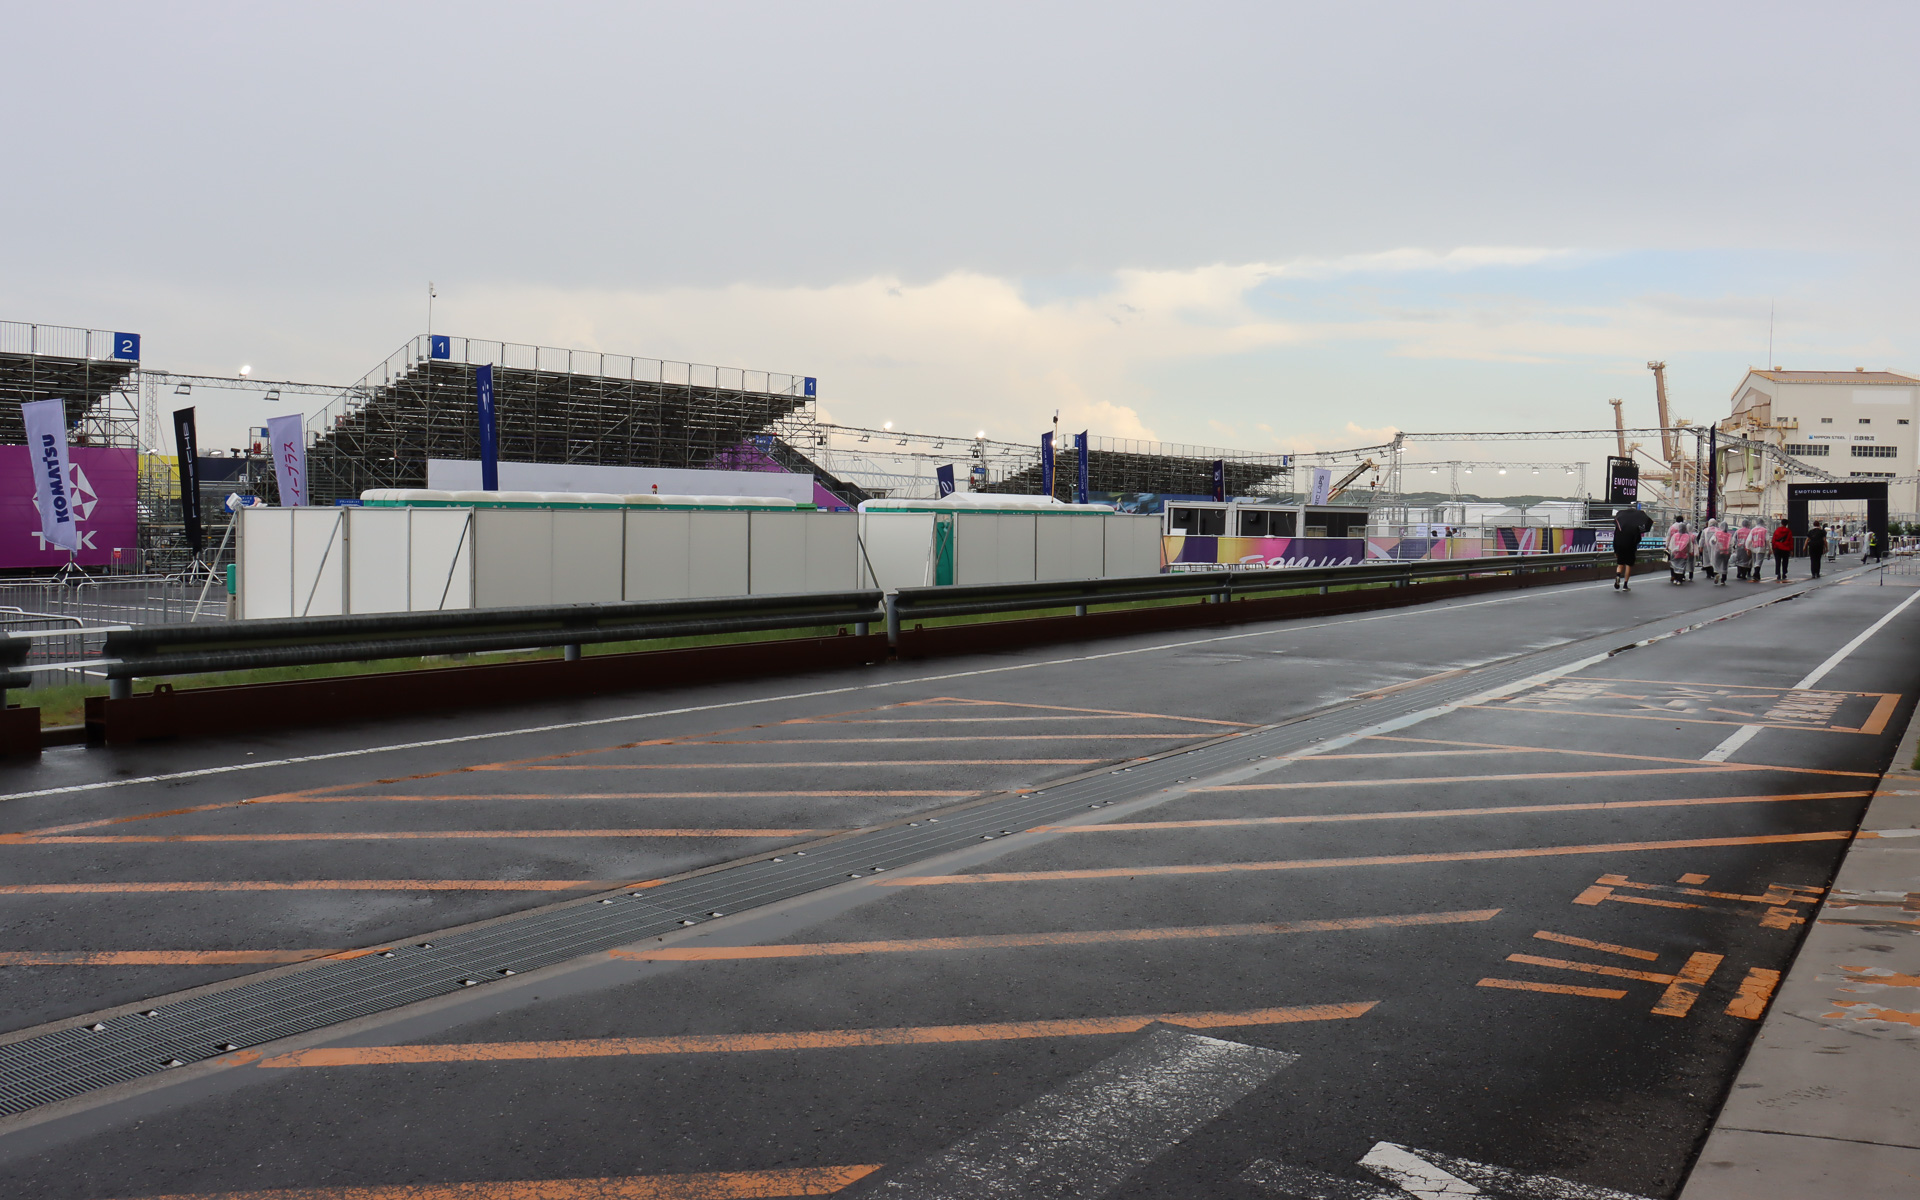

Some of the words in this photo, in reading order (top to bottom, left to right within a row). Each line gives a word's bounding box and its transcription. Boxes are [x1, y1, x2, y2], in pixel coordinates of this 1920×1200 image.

[122, 339, 133, 353] 2
[438, 341, 445, 354] 1
[808, 381, 814, 391] 1
[283, 441, 300, 498] イープラス
[42, 434, 70, 523] KOMATSU
[1614, 477, 1637, 487] EMOTION
[1622, 487, 1637, 496] CLUB
[31, 530, 98, 551] TK
